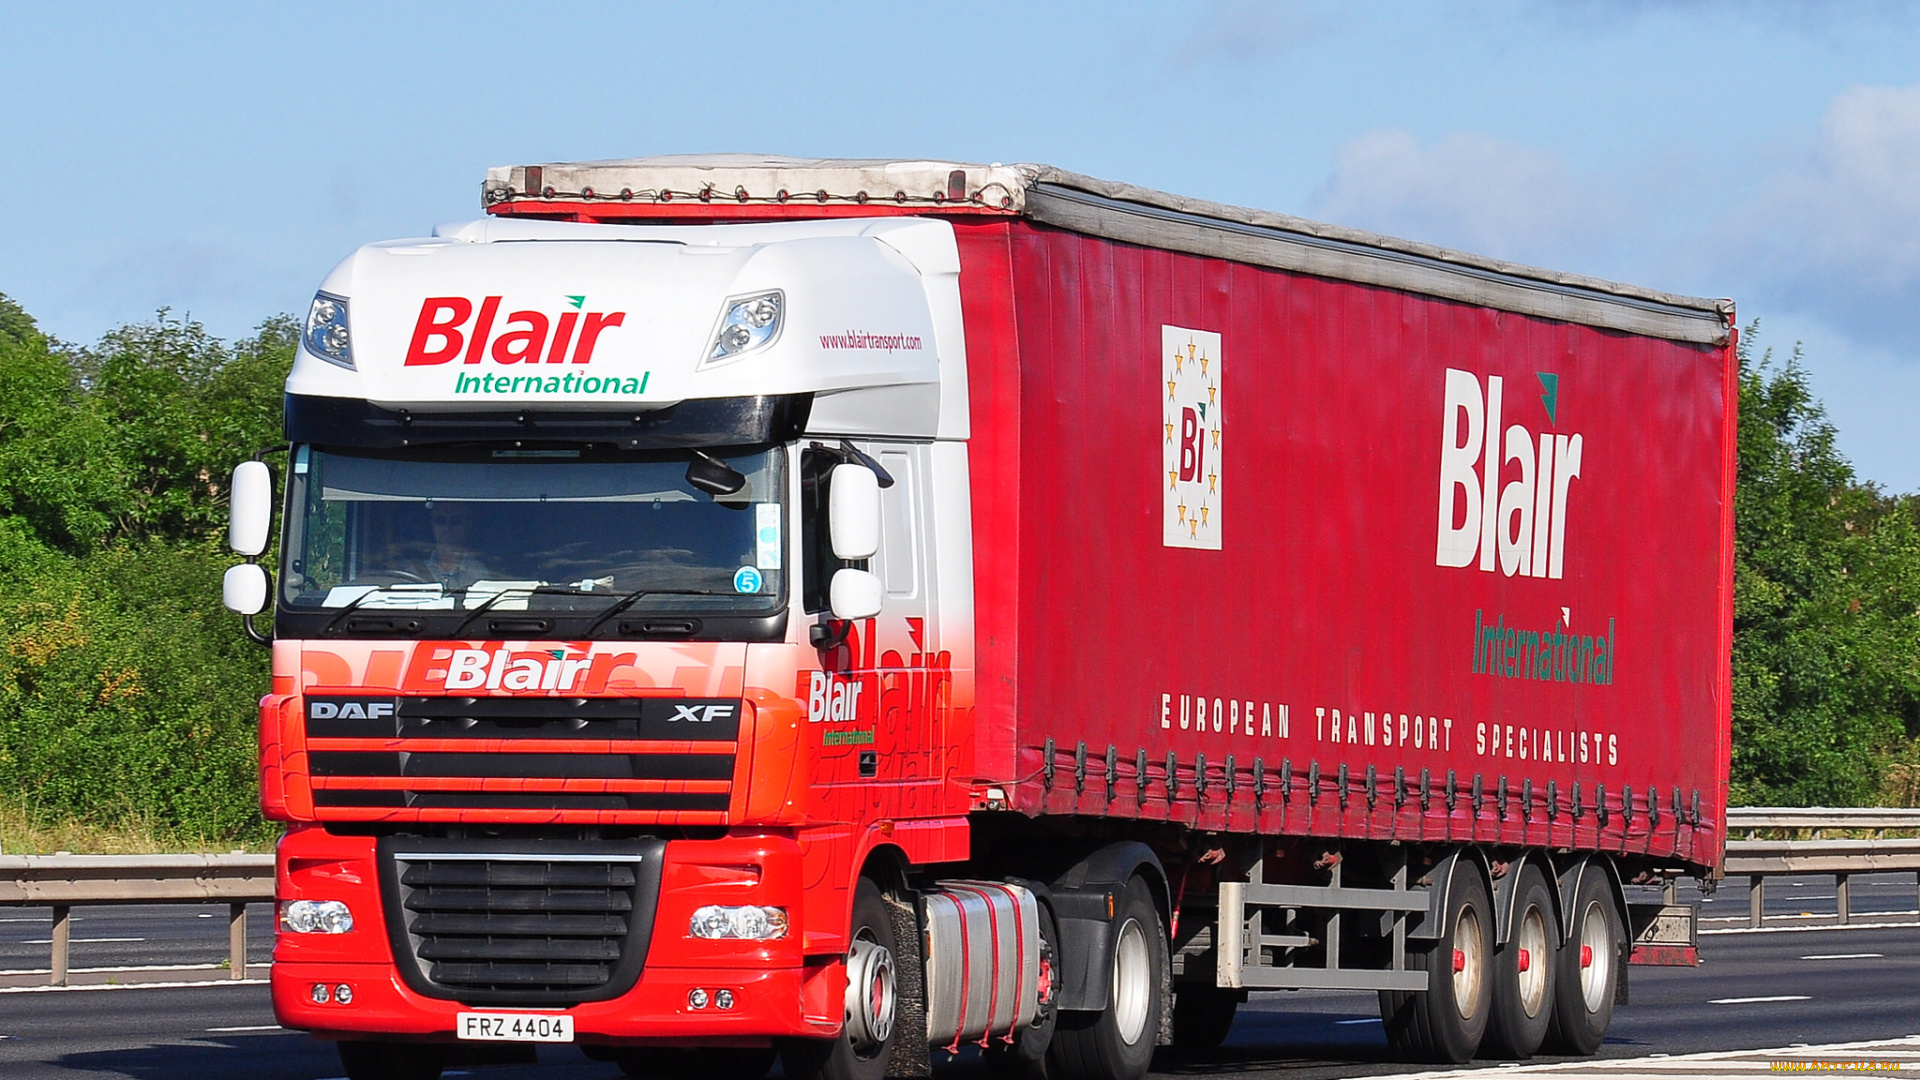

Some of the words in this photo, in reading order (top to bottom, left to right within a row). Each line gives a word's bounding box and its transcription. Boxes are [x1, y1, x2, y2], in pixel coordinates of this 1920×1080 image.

[404, 295, 626, 367] Blair
[819, 329, 922, 354] www.blairtransport.com
[454, 370, 650, 395] International
[1436, 367, 1583, 580] Blair
[1472, 606, 1615, 685] International
[444, 649, 592, 691] Blair
[310, 702, 394, 719] DAF
[667, 705, 735, 722] XF
[808, 671, 862, 723] Blair
[822, 727, 876, 747] International
[1161, 693, 1290, 739] EUROPEAN
[1315, 707, 1453, 752] TRANSPORT
[1476, 722, 1618, 766] SPECIALISTS
[466, 1017, 505, 1037] FRZ
[512, 1018, 564, 1038] 4404
